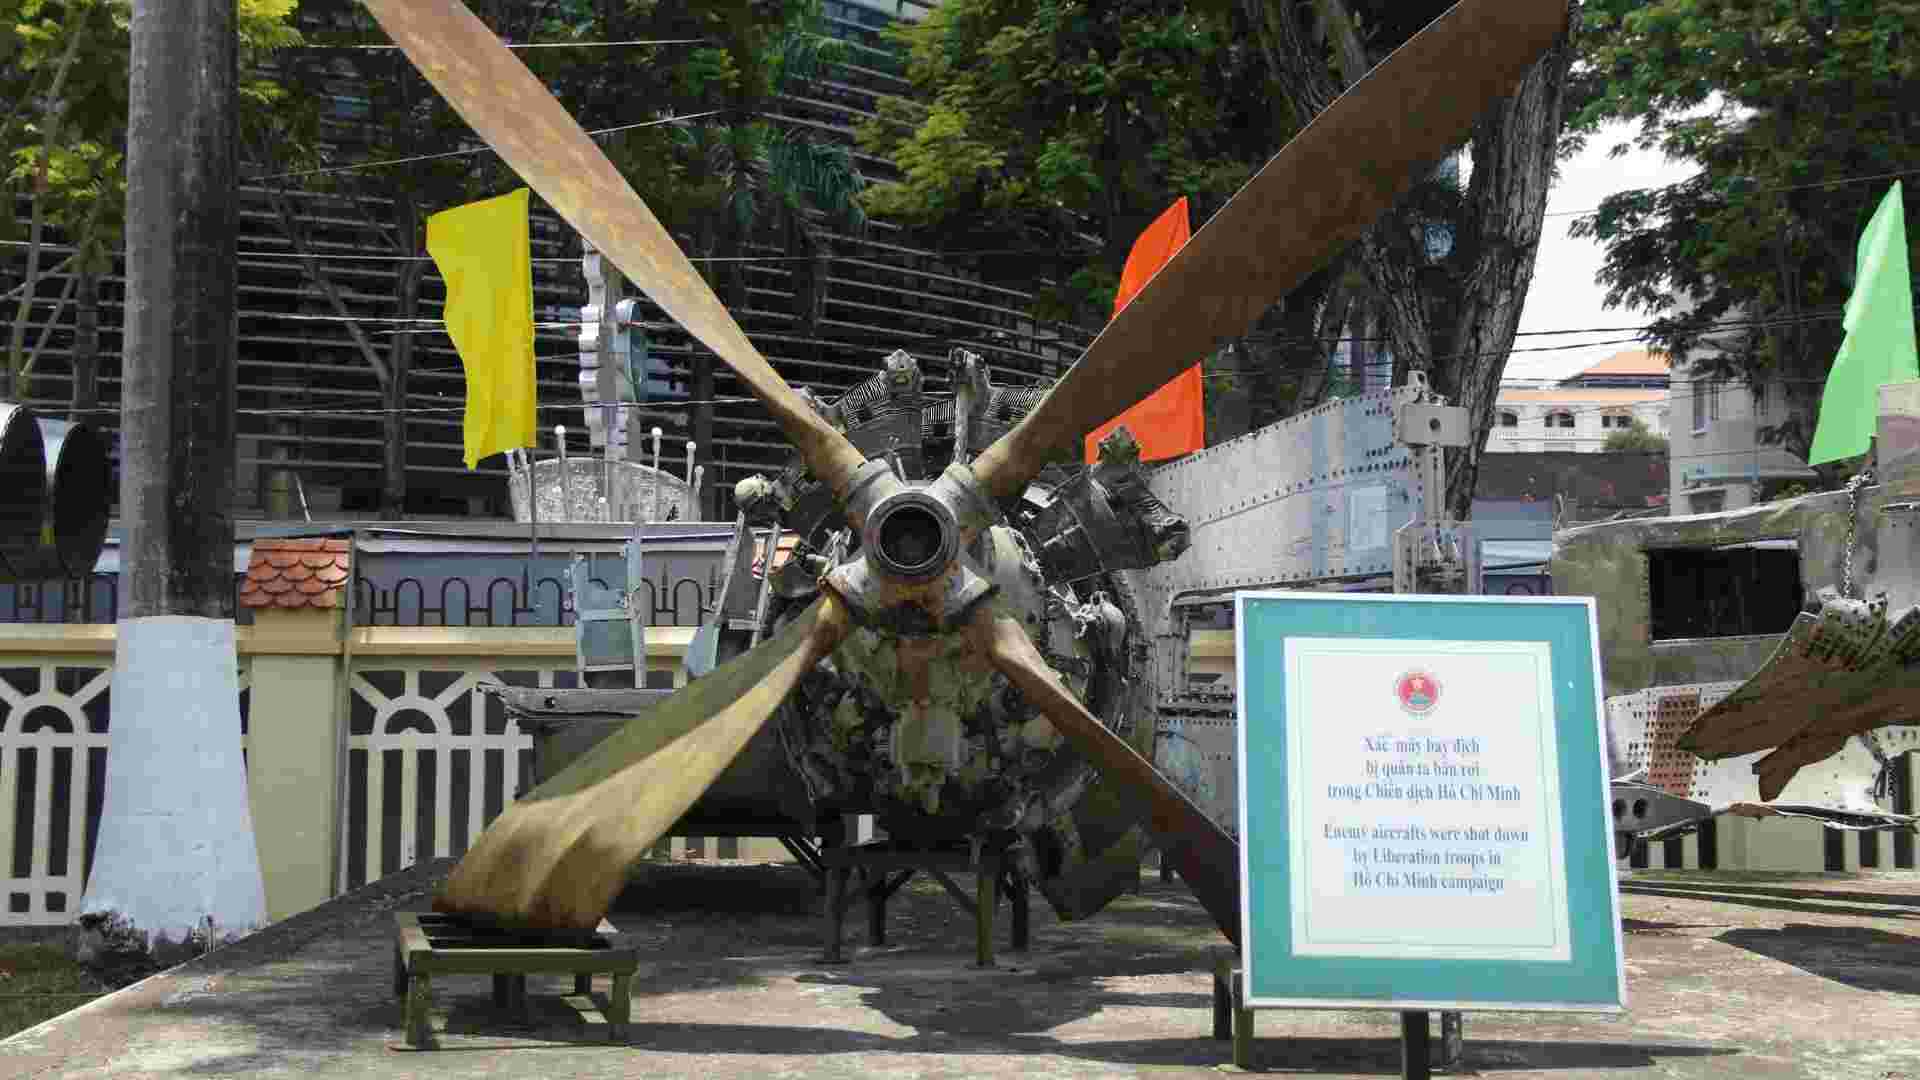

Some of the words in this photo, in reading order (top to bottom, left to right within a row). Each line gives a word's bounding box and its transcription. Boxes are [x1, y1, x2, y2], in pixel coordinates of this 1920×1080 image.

[1426, 736, 1448, 758] bay
[1416, 763, 1430, 776] ta
[1328, 784, 1362, 803] trong
[1487, 785, 1521, 801] Minh
[1324, 823, 1368, 845] Enemy
[1371, 823, 1427, 841] aircrafts
[1430, 827, 1460, 841] were
[1463, 825, 1489, 841] shot
[1494, 825, 1529, 842] down
[1352, 847, 1368, 872] by
[1373, 847, 1440, 865] Liberation
[1444, 849, 1486, 871] troops
[1489, 848, 1501, 865] in
[1401, 872, 1438, 889] Minh
[1441, 873, 1505, 897] campaign
